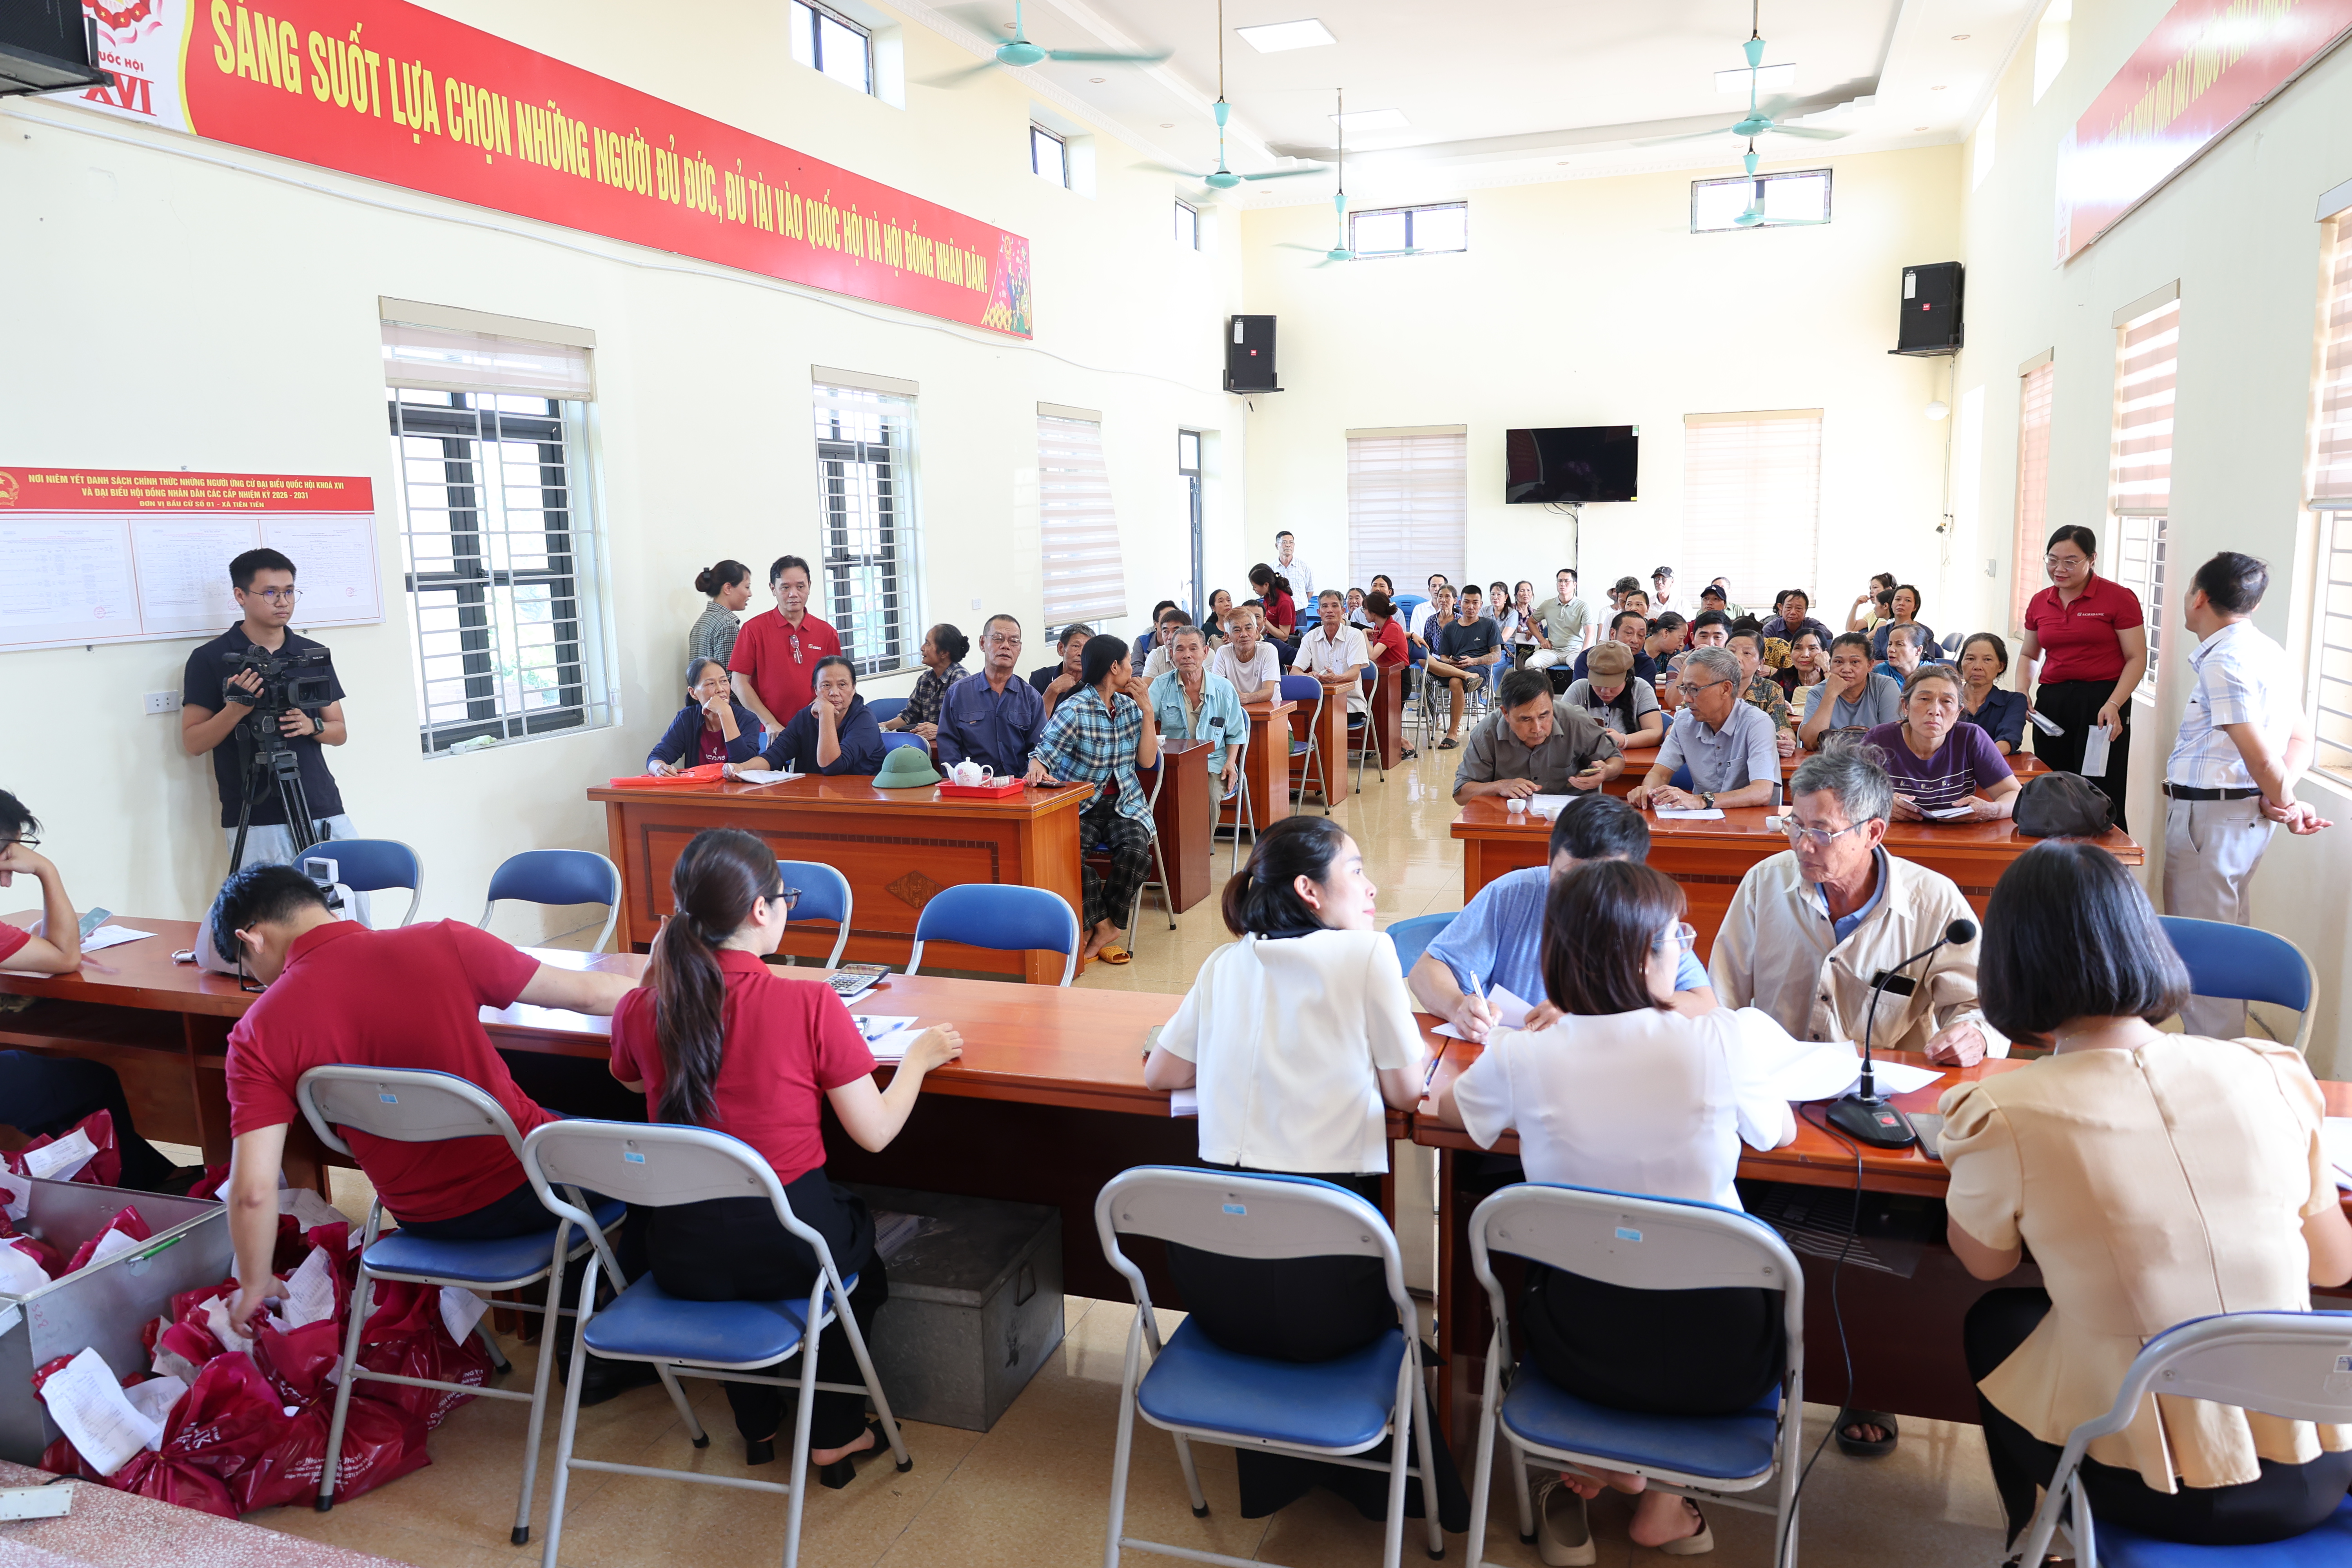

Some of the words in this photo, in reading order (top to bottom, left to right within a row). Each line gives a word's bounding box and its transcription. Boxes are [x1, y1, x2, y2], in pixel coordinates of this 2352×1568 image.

[98, 51, 121, 65] UỐC
[125, 58, 144, 73] HỘI
[211, 0, 302, 94] SÁNG
[309, 22, 381, 118] SUỐT
[388, 58, 441, 144] LỰA
[445, 77, 512, 165] CHỌN
[515, 99, 590, 179] NHỮNG
[593, 126, 653, 197] NGƯỜI
[655, 134, 680, 205] ĐỦ
[683, 150, 722, 223] ĐỨC,
[725, 158, 746, 224] ĐỦ
[749, 171, 773, 232] TÀI
[775, 181, 804, 241] VÀO
[806, 189, 840, 251] QUỐC
[843, 203, 864, 267] HỘI
[866, 211, 882, 263] VÀ
[884, 217, 903, 277] HỘI
[904, 219, 934, 278] ĐỒNG
[935, 238, 964, 287] NHÂN
[965, 245, 988, 294] DÂN!
[28, 474, 44, 483] NƠI
[46, 474, 68, 484] NIÊM
[70, 473, 84, 484] YẾT
[87, 476, 109, 485] DANH
[111, 475, 132, 485] SÁCH
[134, 475, 157, 486] CHÍNH
[159, 476, 178, 486] THỨC
[180, 477, 205, 486] NHỮNG
[206, 478, 228, 487] NGƯỜI
[230, 477, 245, 488] ỨNG
[246, 477, 256, 488] CỬ
[257, 480, 268, 489] ĐẠI
[269, 478, 284, 488] BIỂU
[286, 477, 303, 489] QUỐC
[304, 480, 315, 490] HỘI
[316, 480, 333, 489] KHOÁ
[82, 486, 93, 496] VÀ
[94, 488, 109, 498] ĐẠI
[110, 486, 128, 497] BIỂU
[131, 487, 143, 498] HỘI
[145, 486, 166, 497] ĐỒNG
[168, 488, 189, 497] NHÂN
[190, 488, 205, 497] DÂN
[207, 488, 221, 498] CÁC
[223, 488, 236, 498] CẤP
[238, 490, 260, 500] NHIỆM
[262, 489, 270, 499] KỲ
[249, 499, 264, 508] TIẾN
